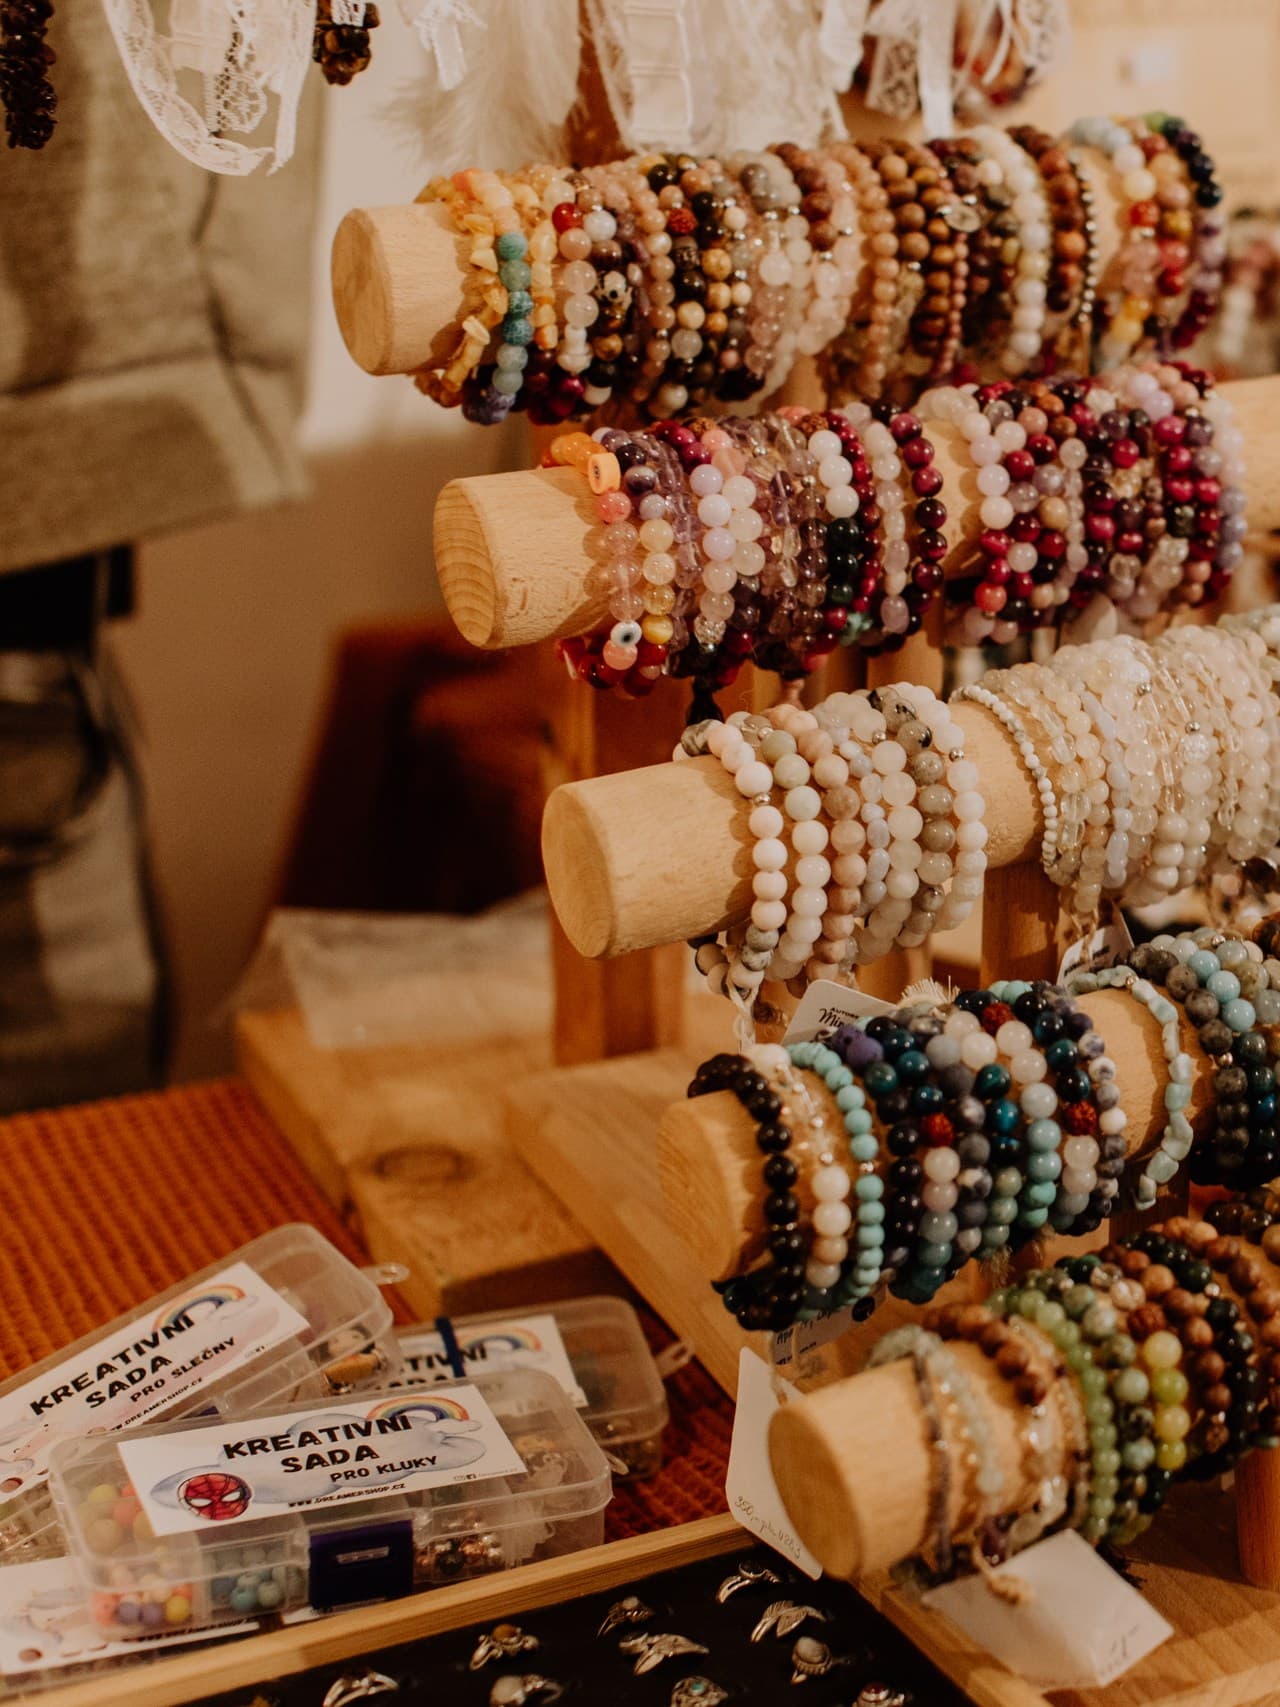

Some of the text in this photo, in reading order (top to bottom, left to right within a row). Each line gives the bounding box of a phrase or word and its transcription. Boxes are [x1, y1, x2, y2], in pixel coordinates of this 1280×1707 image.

[85, 1355, 173, 1409] SADA
[130, 1378, 165, 1403] PRO
[170, 1336, 236, 1378] SLEČNY
[280, 1444, 380, 1473] SADA
[330, 1467, 370, 1483] PRO
[377, 1455, 438, 1475] KLUKY
